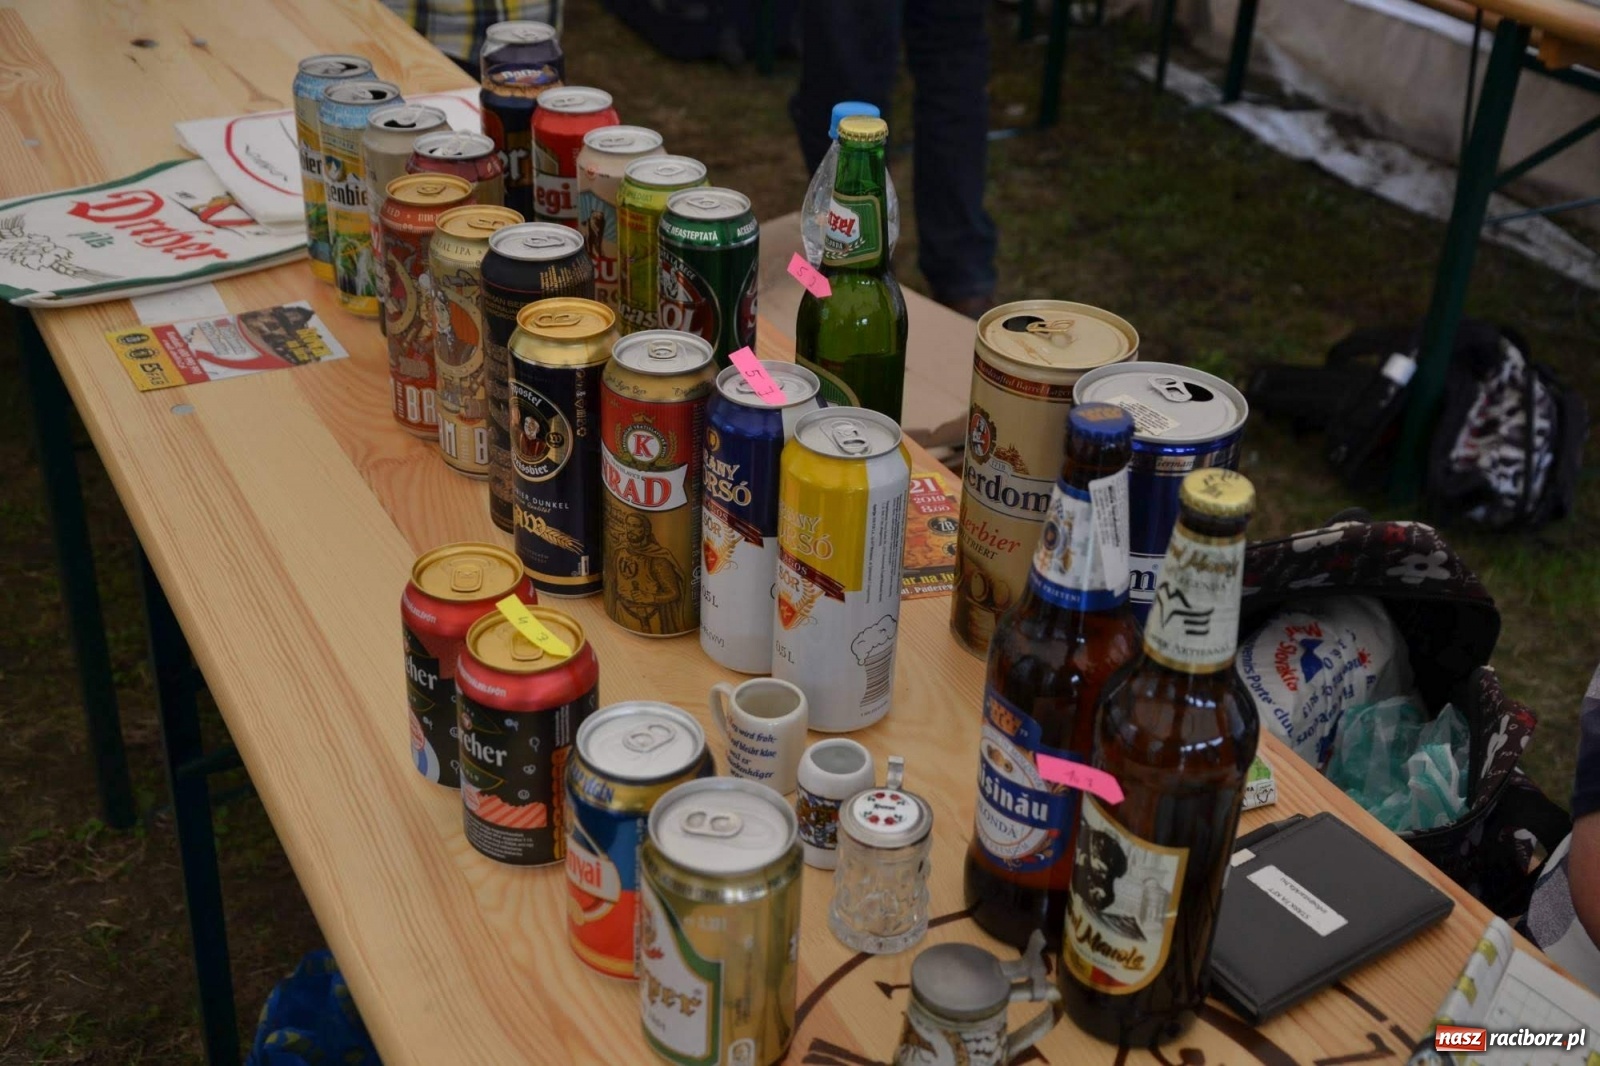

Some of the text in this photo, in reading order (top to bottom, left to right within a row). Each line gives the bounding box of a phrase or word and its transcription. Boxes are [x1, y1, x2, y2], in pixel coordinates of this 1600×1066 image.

[1016, 379, 1047, 395] Barrel
[632, 433, 654, 458] K
[532, 497, 570, 510] DUNKEL
[913, 495, 946, 504] 2019
[920, 574, 938, 584] na
